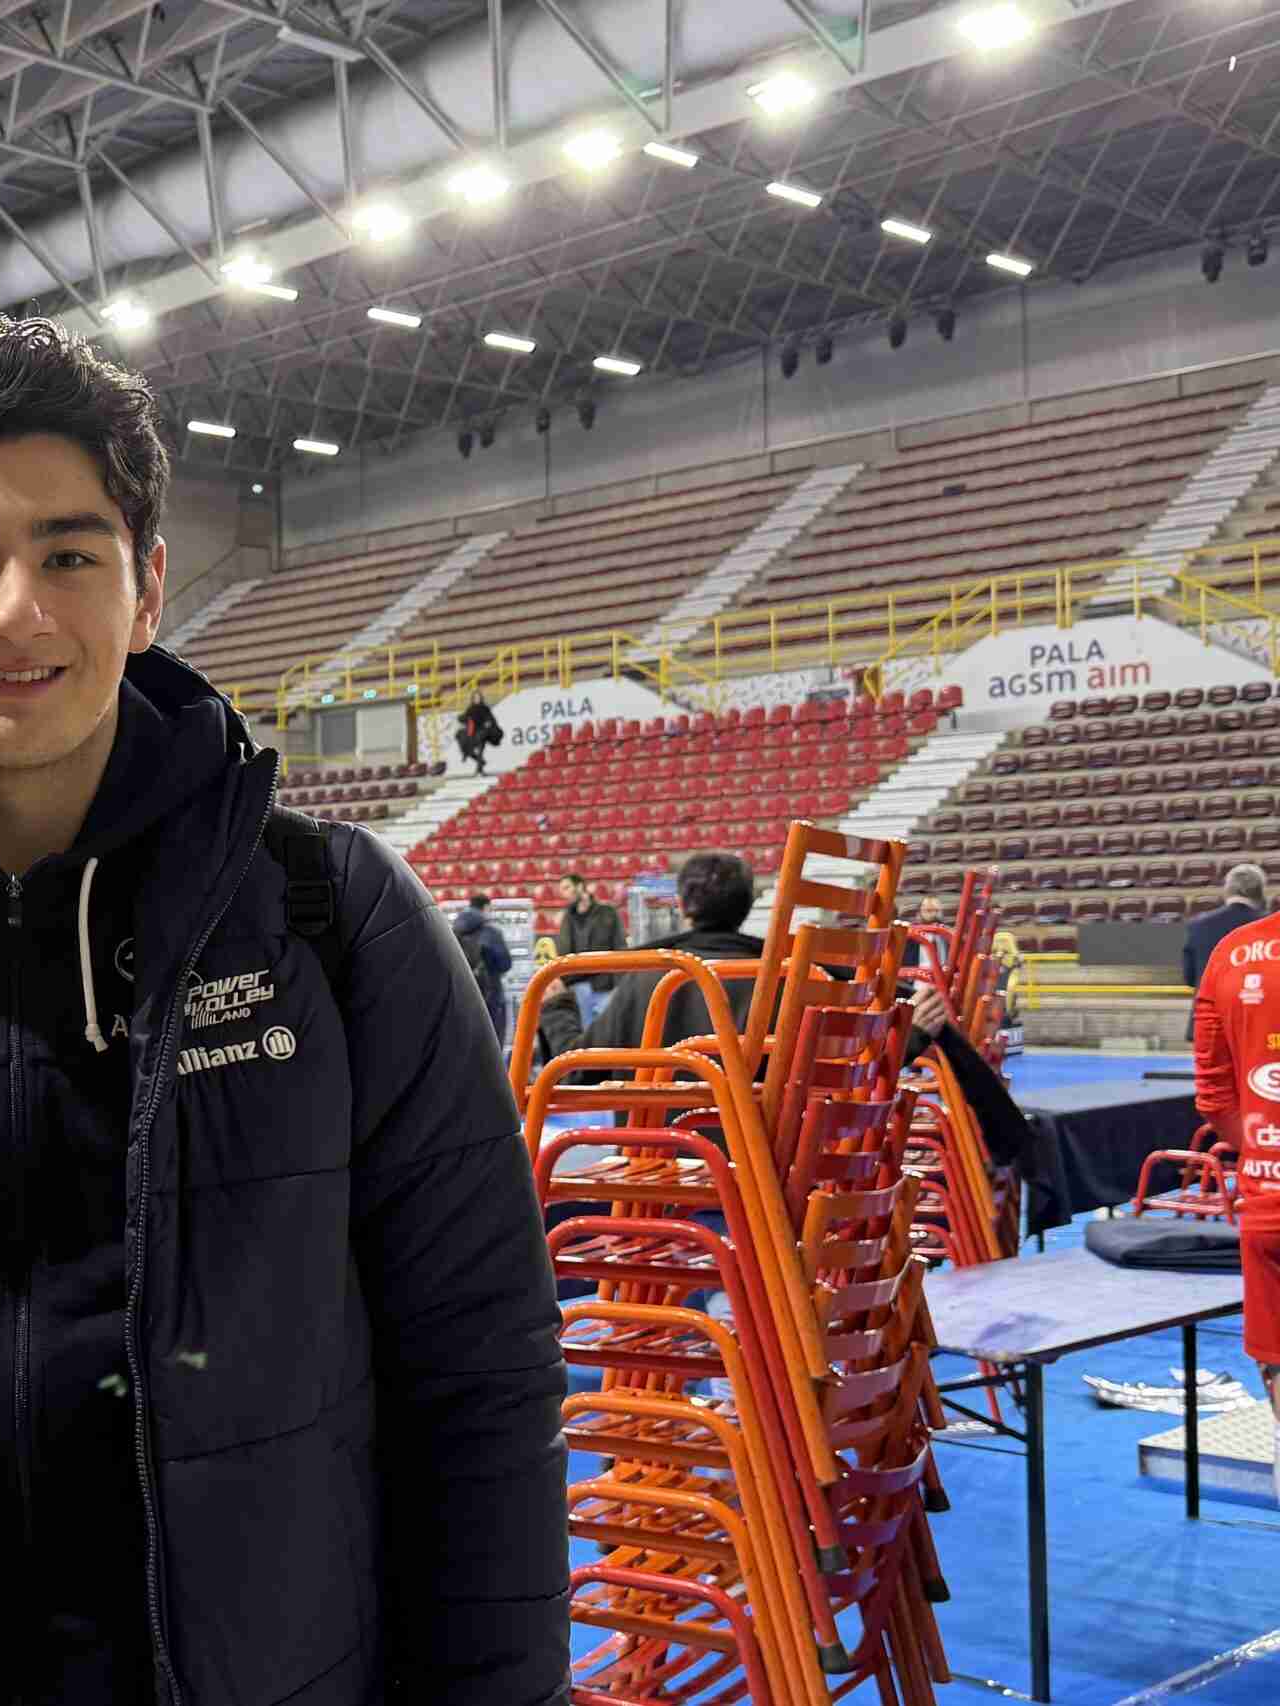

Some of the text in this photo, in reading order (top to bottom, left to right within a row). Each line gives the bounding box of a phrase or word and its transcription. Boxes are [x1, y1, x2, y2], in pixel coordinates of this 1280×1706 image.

[1029, 638, 1105, 667] PALA
[1087, 661, 1151, 690] aim
[541, 696, 593, 718] PALA
[177, 1040, 259, 1075] llianz
